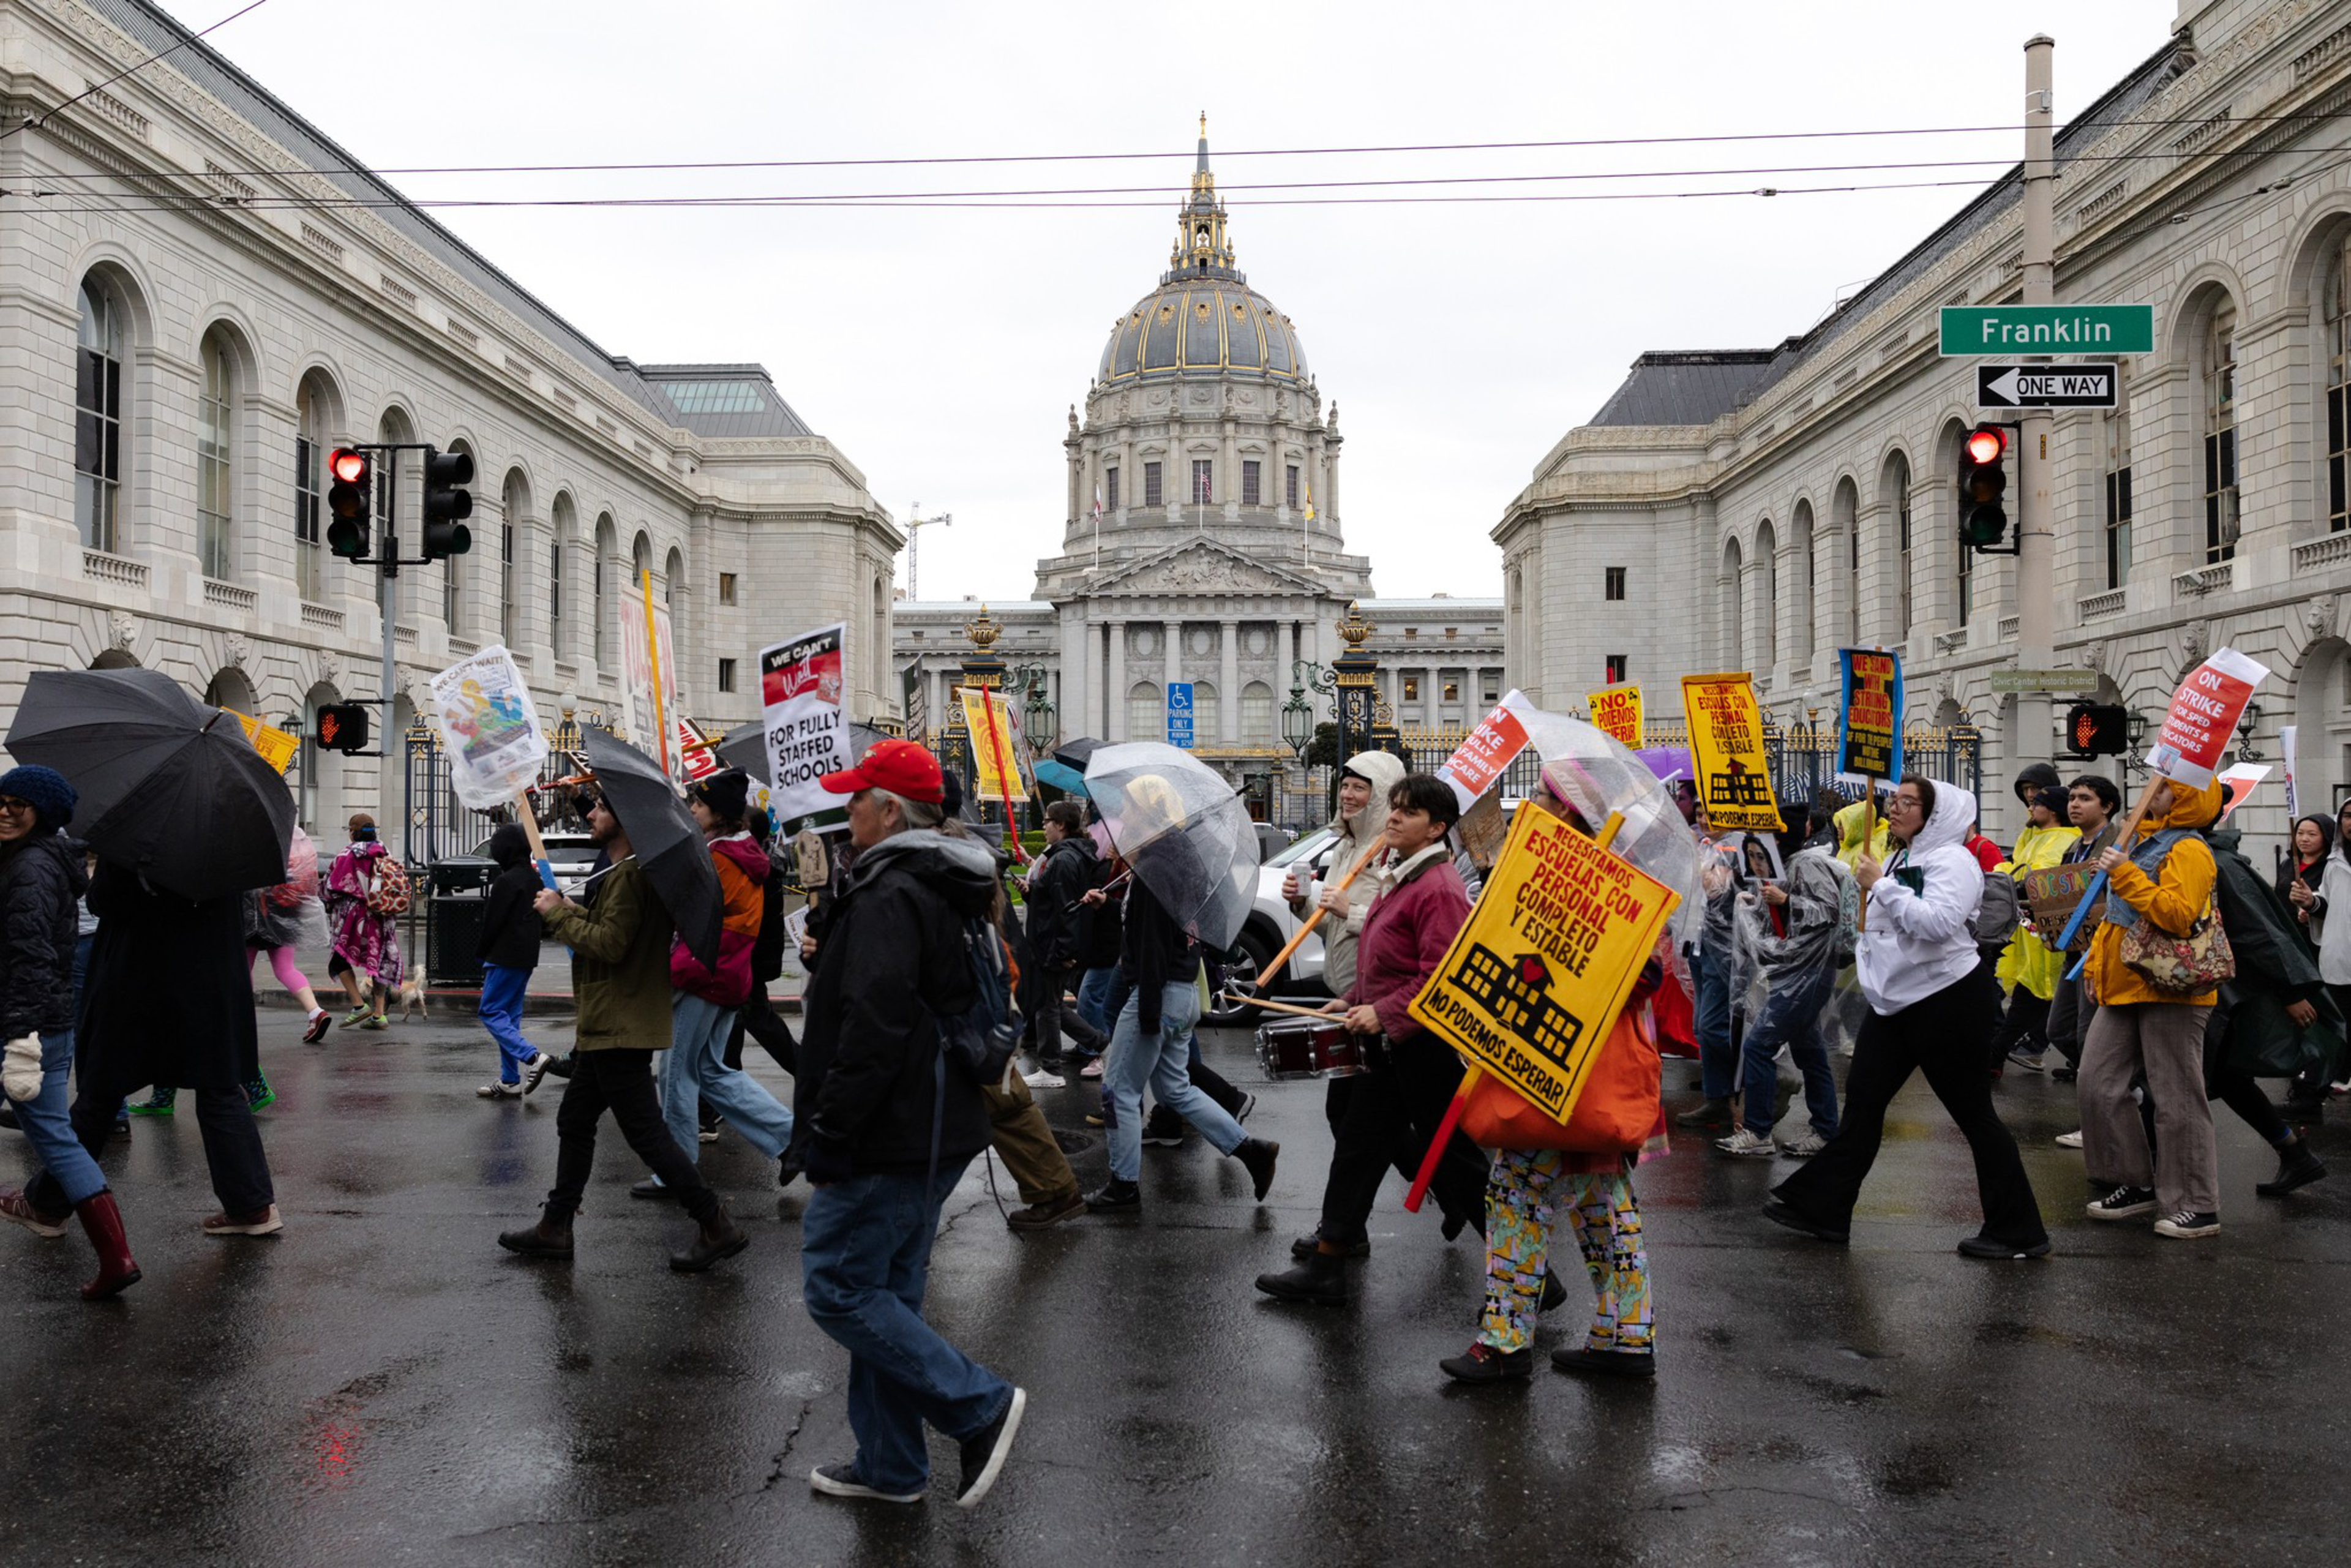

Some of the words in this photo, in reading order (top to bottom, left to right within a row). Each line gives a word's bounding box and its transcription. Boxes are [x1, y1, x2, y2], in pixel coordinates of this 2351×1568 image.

[1982, 317, 2111, 343] Franklin
[2017, 377, 2056, 395] ONE
[2062, 377, 2103, 395] WAY
[770, 651, 790, 669] WE
[793, 637, 832, 659] CAN'T
[1853, 655, 1867, 672] WE
[1870, 656, 1891, 674] SAND
[1993, 677, 2011, 686] Civic
[2069, 677, 2095, 685] District
[2199, 671, 2222, 691] ON
[1168, 708, 1193, 718] PARKING
[1488, 708, 1507, 723] N
[1600, 693, 1627, 711] NO
[1698, 696, 1731, 710] ESCULAS
[2179, 687, 2225, 718] STRIKE
[770, 724, 795, 748] FOR
[800, 709, 841, 737] FULLY
[1172, 719, 1188, 729] ONLY
[2174, 705, 2188, 718] FOR
[2187, 712, 2210, 727] SPED
[779, 735, 833, 767] STAFFED
[2200, 732, 2210, 743] &
[778, 755, 842, 790] SCHOOLS
[1460, 747, 1497, 776] FAMILY
[1553, 824, 1634, 888] NECESITAMOS
[1525, 829, 1601, 897] ESCUELAS
[1605, 887, 1643, 924] CON
[1531, 863, 1613, 934] PERSONAL
[1517, 882, 1600, 953] COMPLETO
[1509, 906, 1523, 927] Y
[1521, 918, 1590, 979] ESTABLE
[1428, 988, 1447, 1013] NO
[1448, 1001, 1507, 1060] PODEMOS
[1504, 1048, 1564, 1105] ESPERAR
